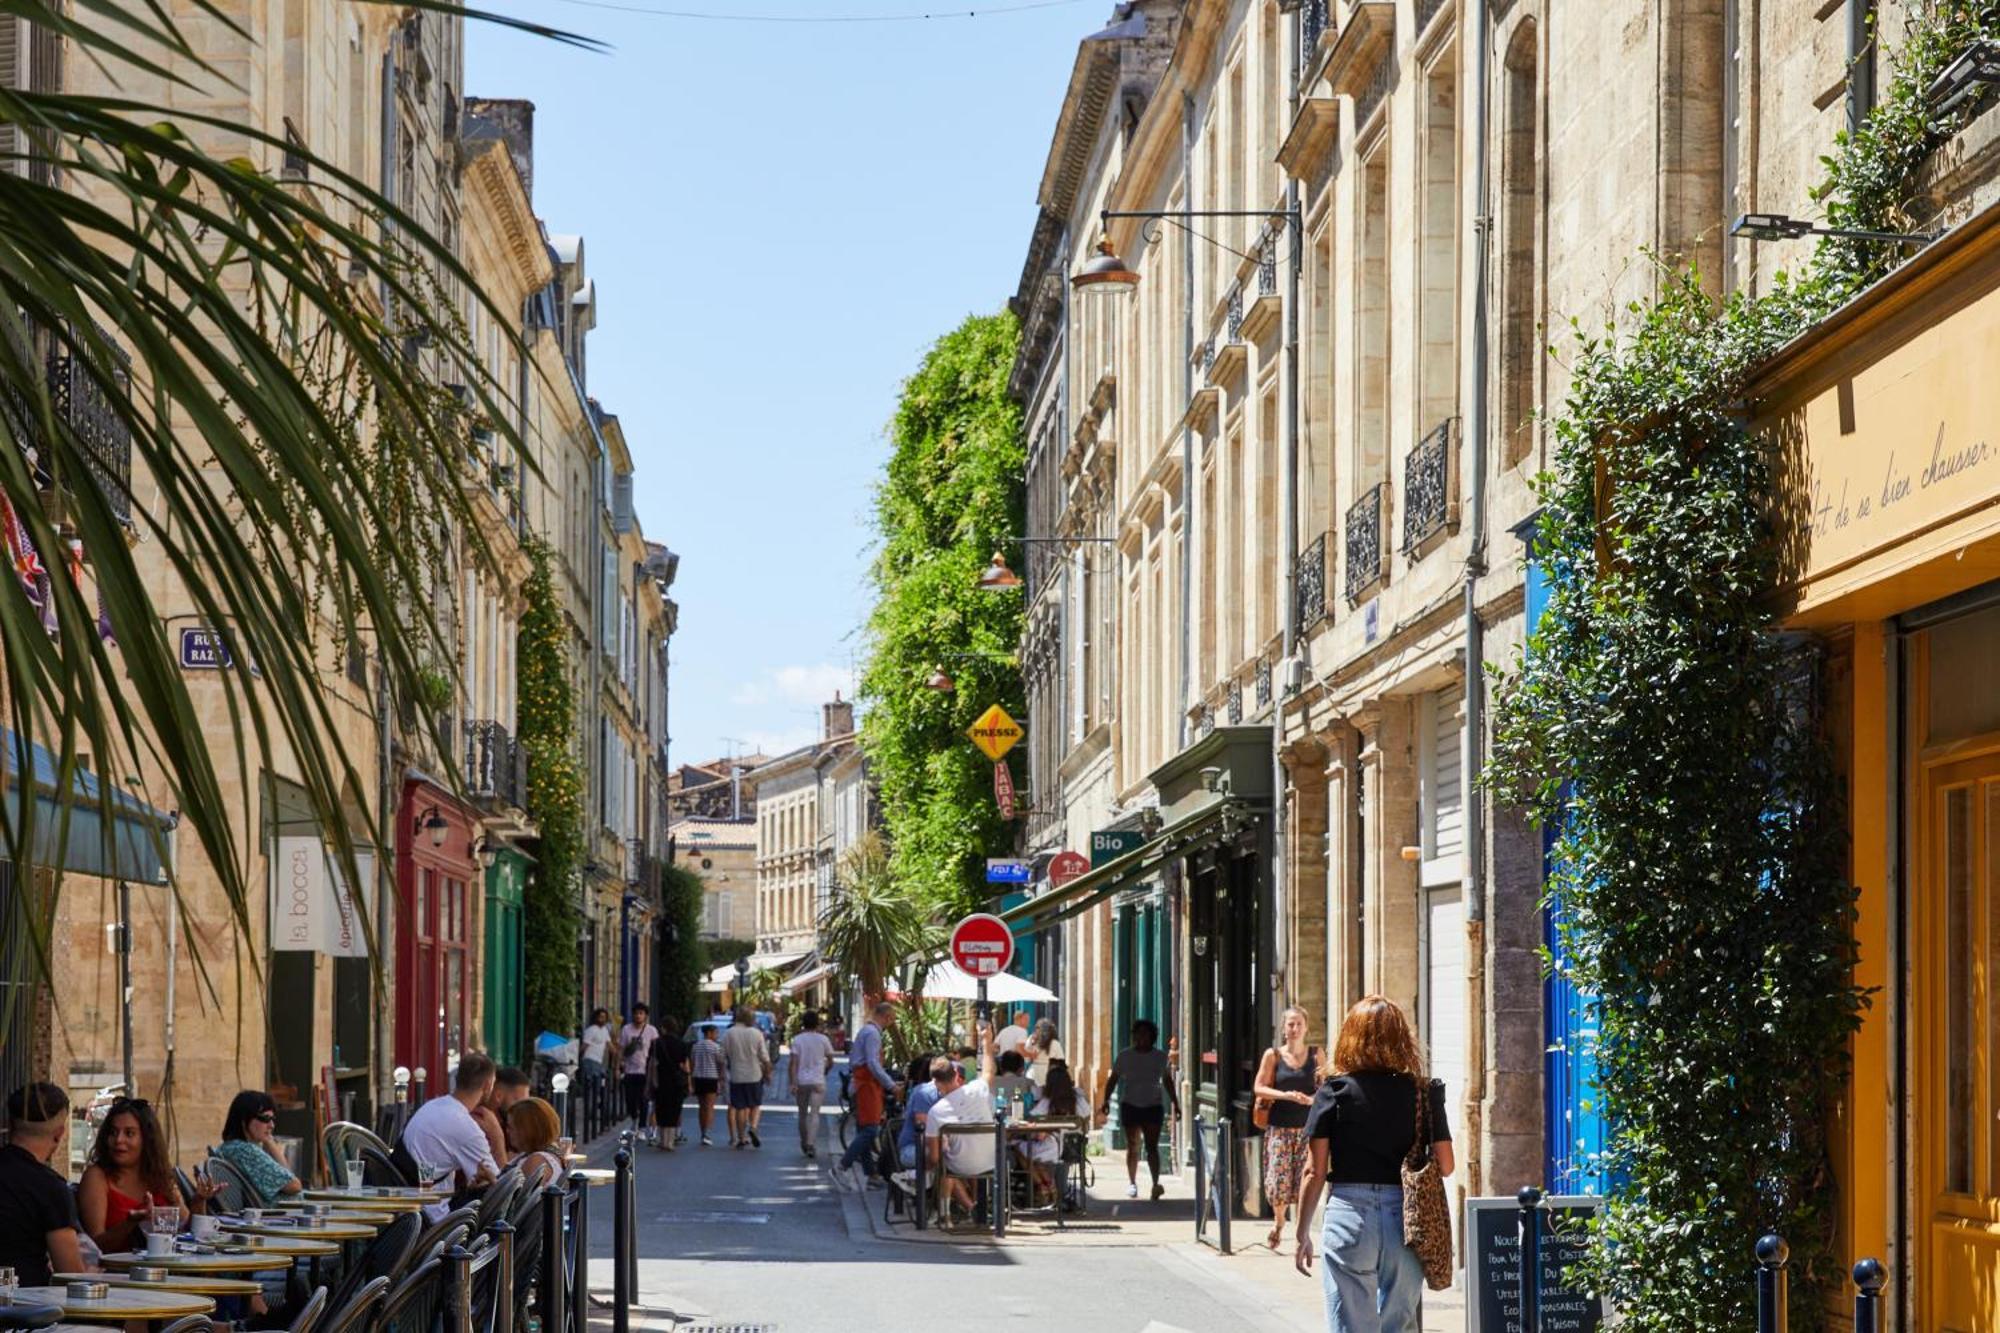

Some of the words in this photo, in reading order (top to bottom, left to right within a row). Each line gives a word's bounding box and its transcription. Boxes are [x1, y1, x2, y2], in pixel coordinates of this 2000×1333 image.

[1835, 477, 1850, 529] de
[1880, 449, 1911, 508] bien
[191, 650, 222, 661] RAZ
[973, 728, 1018, 737] PRESSE
[998, 763, 1012, 817] TABAC
[1094, 835, 1122, 850] Bio
[288, 846, 309, 916] bocca
[288, 922, 309, 942] la
